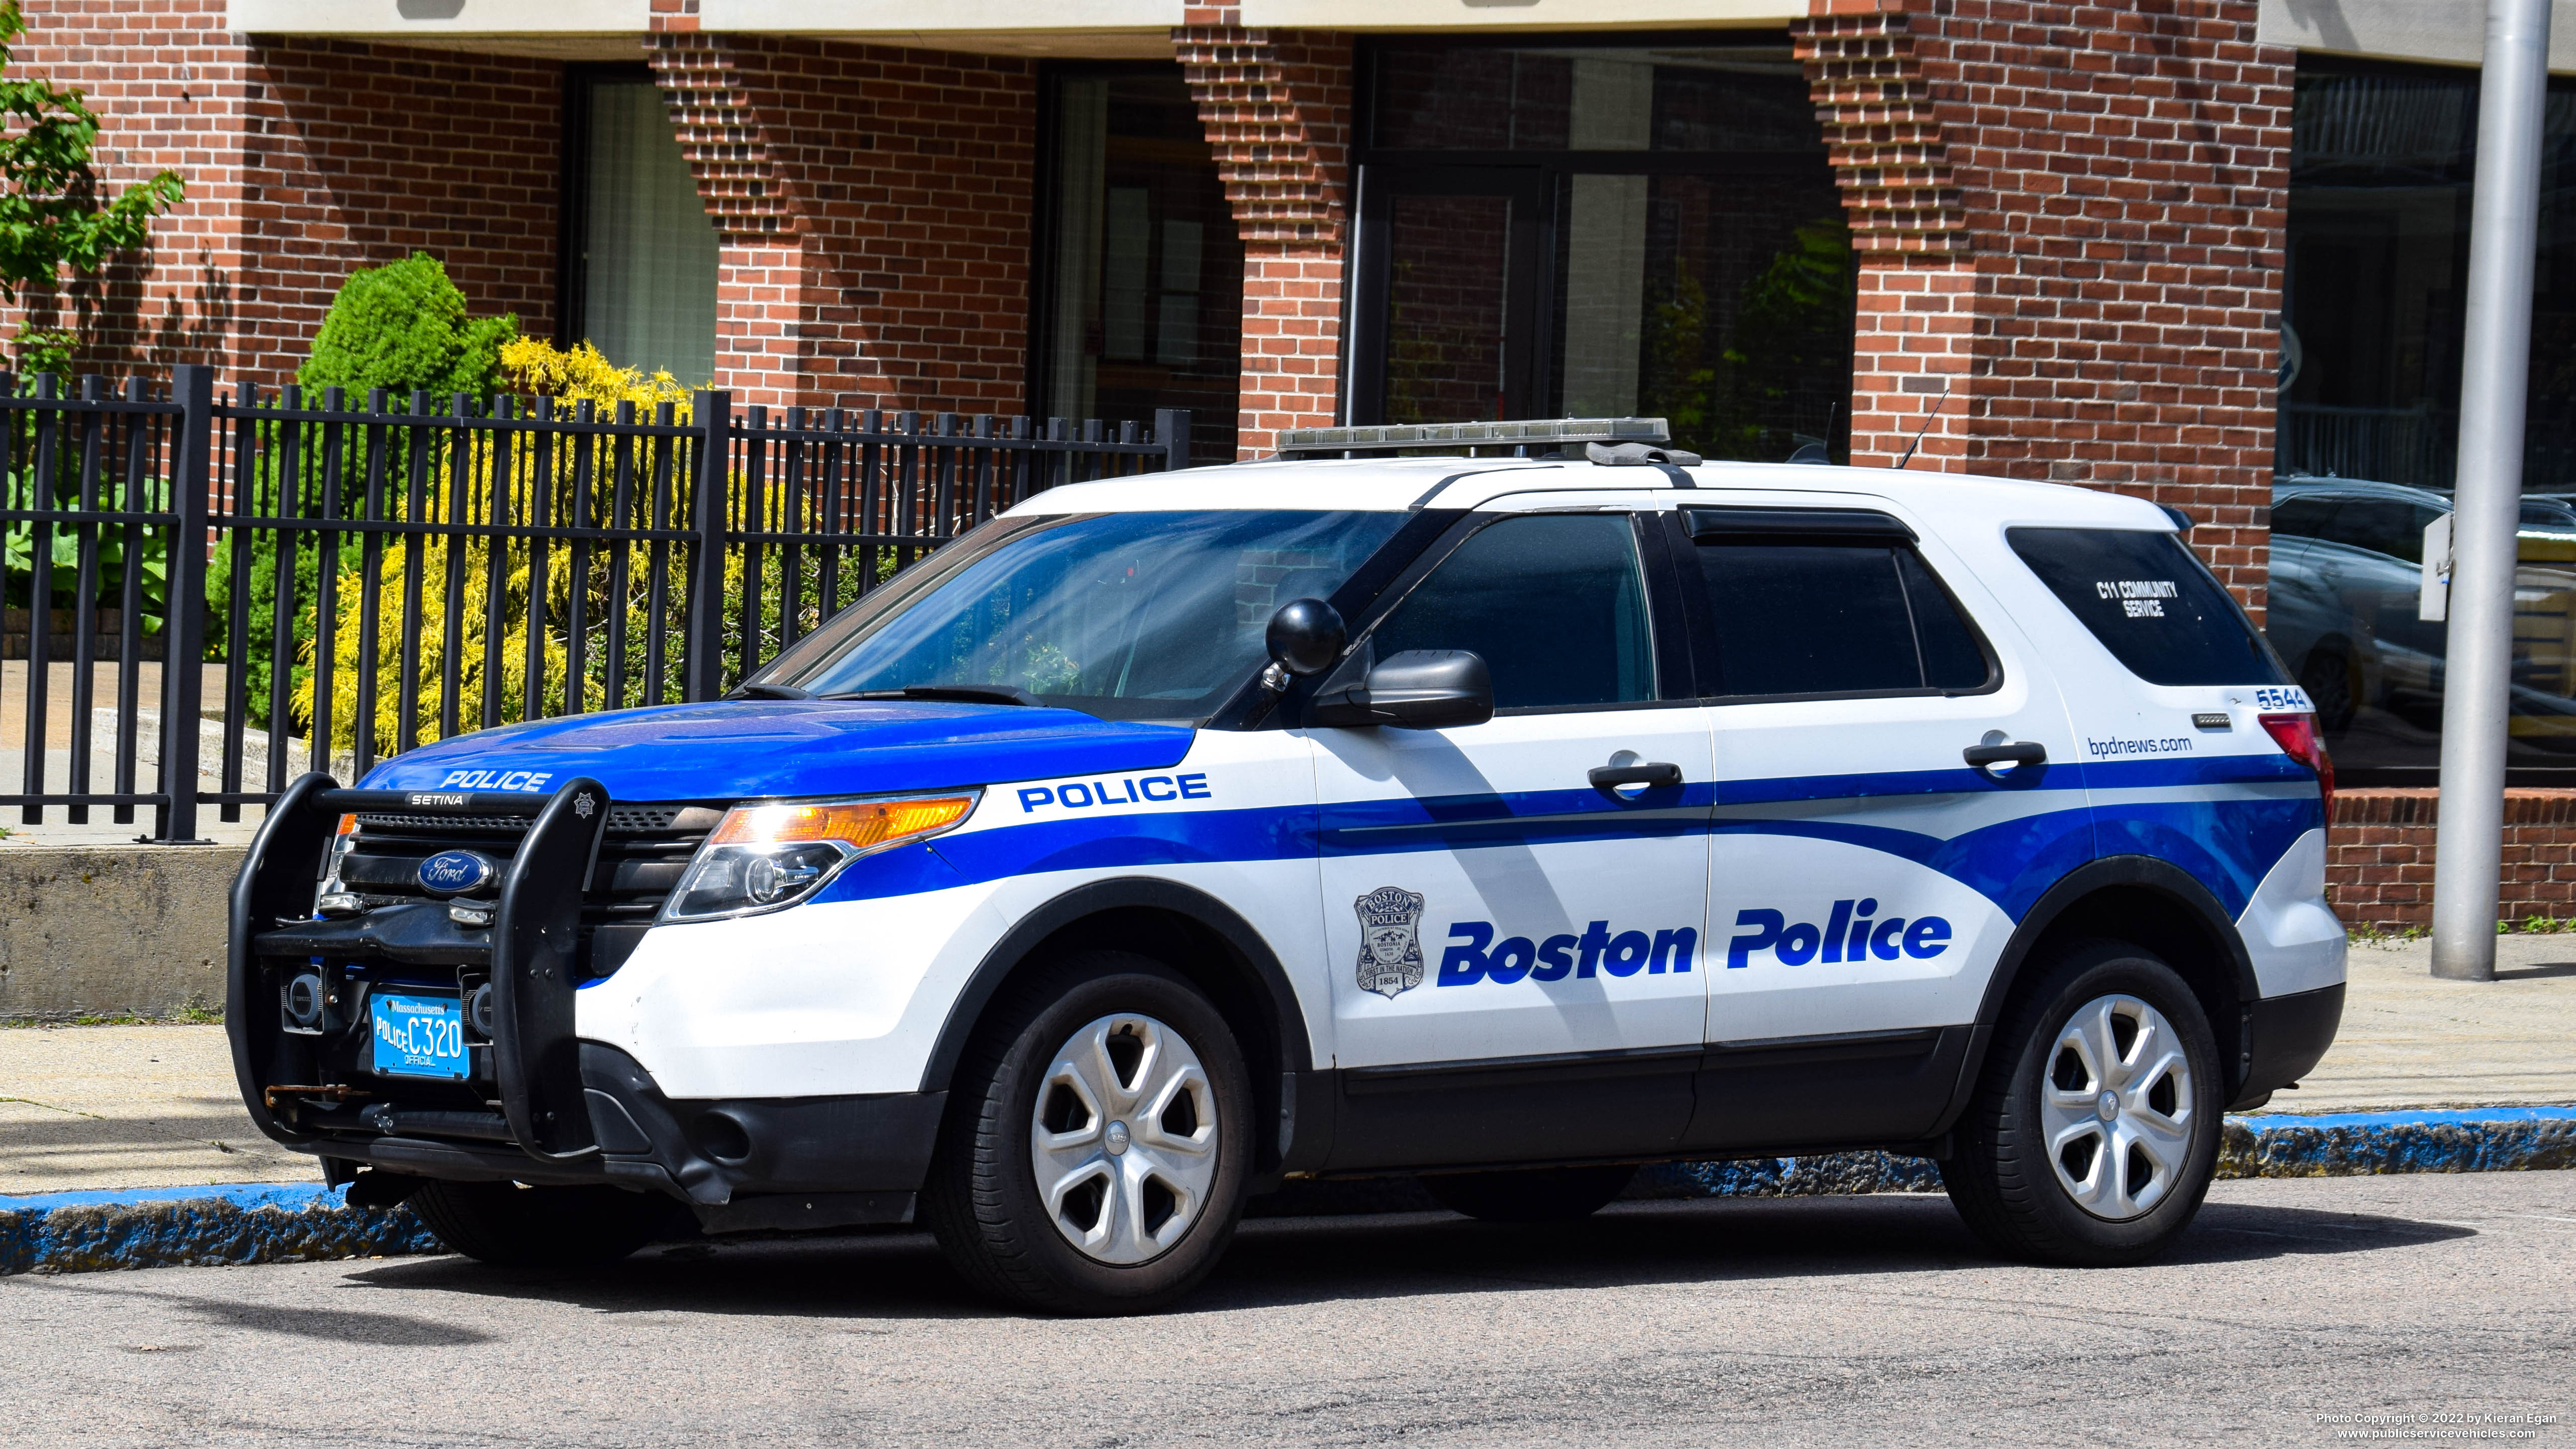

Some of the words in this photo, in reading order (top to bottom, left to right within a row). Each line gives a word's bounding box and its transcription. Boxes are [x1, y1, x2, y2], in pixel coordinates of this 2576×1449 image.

[2096, 581, 2120, 599] C11
[2118, 581, 2178, 598] COMMUNITY
[2123, 600, 2165, 617] SERVICE
[2256, 688, 2308, 710] 5544
[2087, 736, 2192, 760] bpdnews.com
[439, 770, 553, 792] POLICE
[412, 795, 464, 805] SETINA
[1017, 772, 1212, 813] POLICE
[427, 857, 469, 882] Ford
[1367, 891, 1410, 910] BOSTON
[1371, 914, 1407, 925] POLICE
[1436, 921, 1698, 987] Boston
[1727, 897, 1953, 969] Police
[1365, 967, 1378, 976] FIRST
[1396, 965, 1413, 974] NATION
[1379, 977, 1398, 985] 1854
[392, 1000, 444, 1015] Massachusetts
[377, 1016, 408, 1053] POLICE
[408, 1017, 461, 1058] C320
[405, 1054, 436, 1066] OFFICIAL
